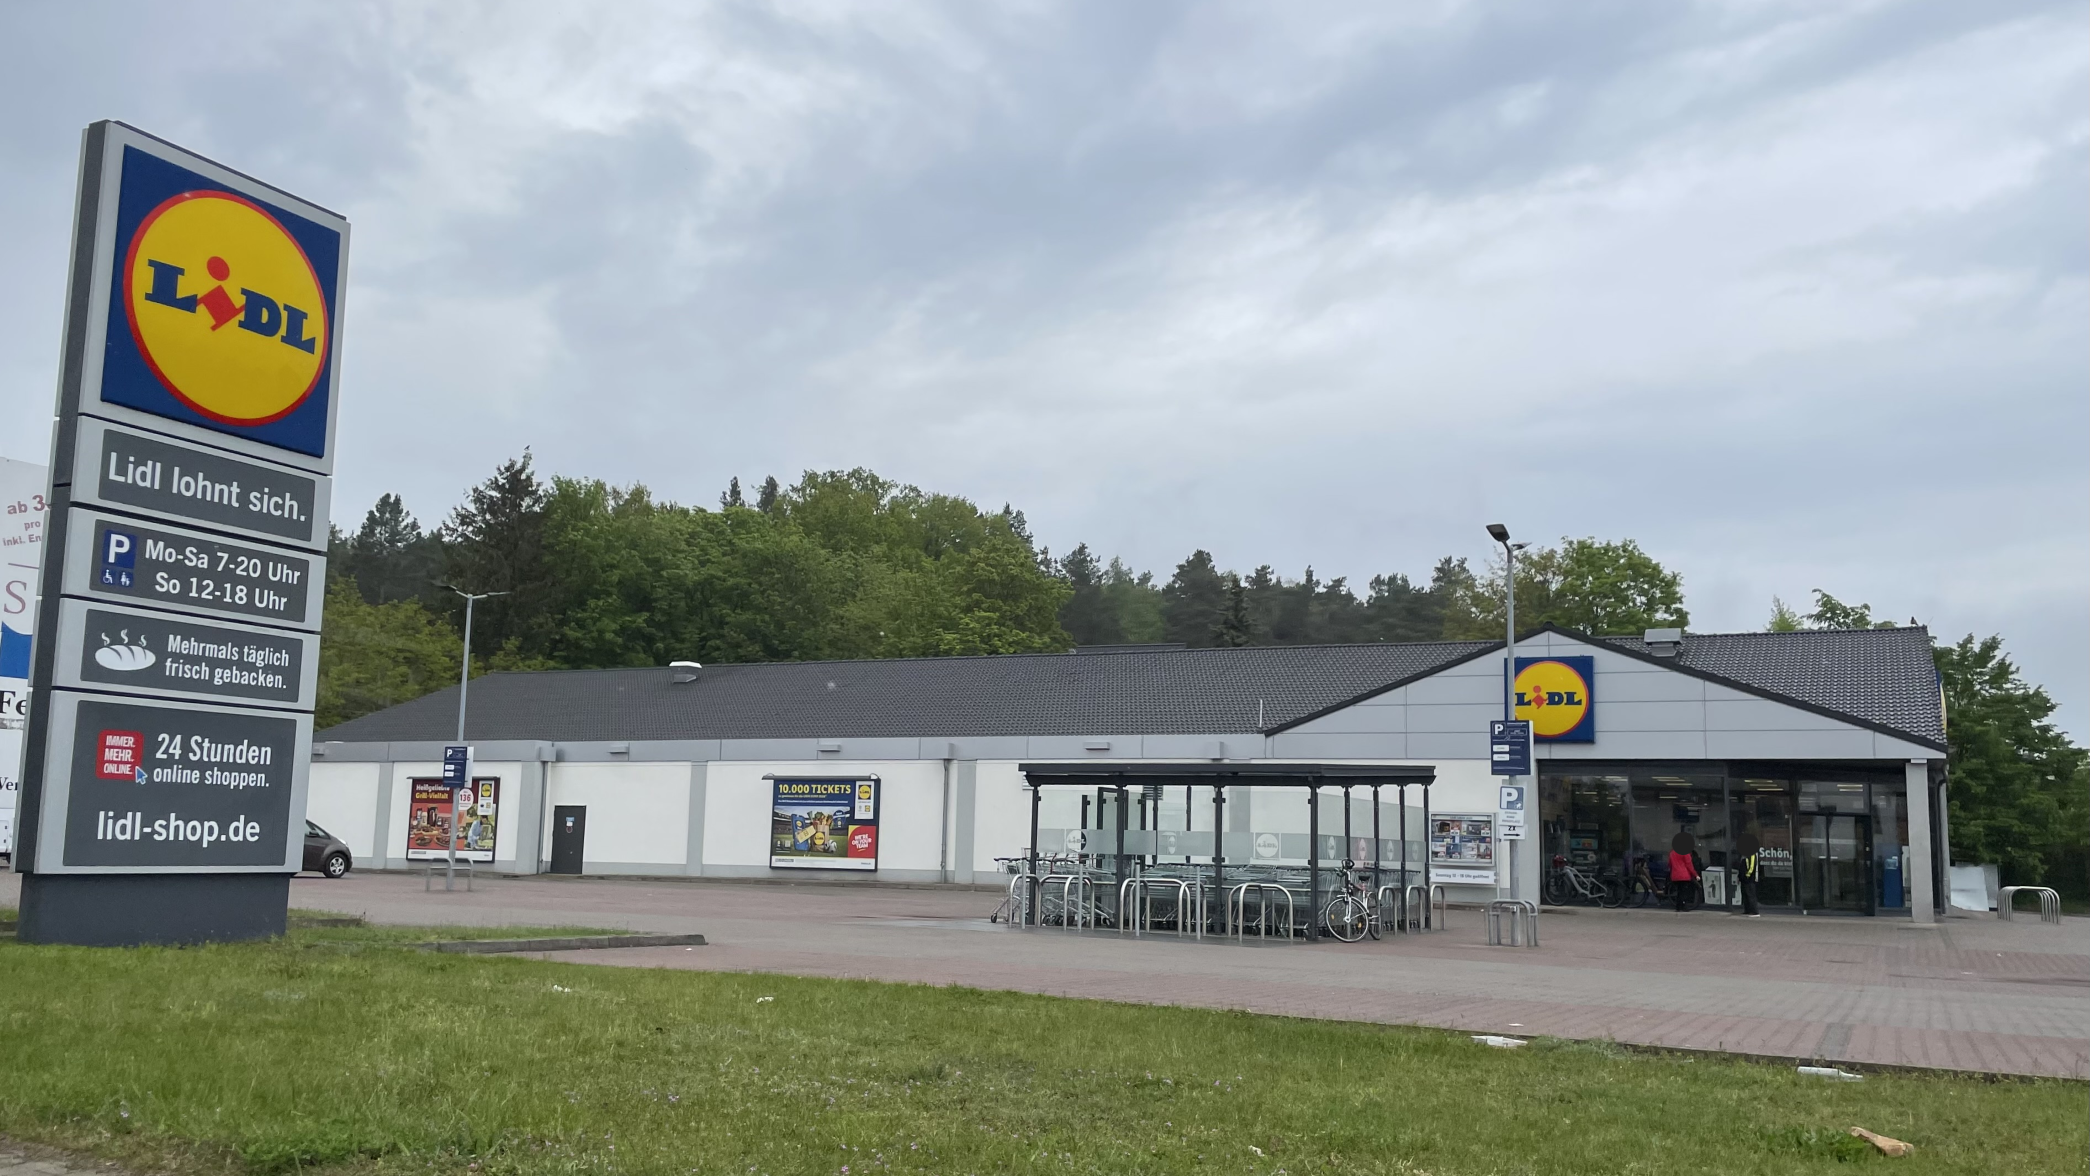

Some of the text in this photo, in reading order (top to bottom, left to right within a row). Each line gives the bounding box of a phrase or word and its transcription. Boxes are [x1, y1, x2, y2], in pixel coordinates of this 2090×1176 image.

[144, 256, 316, 355] LIDL
[108, 452, 306, 522] Lidl lohnt sich.
[7, 501, 28, 514] ab
[24, 521, 41, 532] pro
[2, 536, 26, 546] inkl.
[108, 533, 130, 564] P
[145, 538, 300, 584] Mo-Sa 7-20 Uhr
[154, 572, 288, 611] So 12-18 Uhr
[168, 634, 289, 667] Mehrmals täglich
[165, 658, 287, 689] frisch gebacken.
[1515, 685, 1582, 710] LIDL
[104, 748, 134, 762] MEHR.
[106, 735, 136, 748] IMMER.
[155, 733, 272, 765] 24 Stunden
[103, 763, 133, 775] ONLINE.
[154, 765, 270, 790] online shoppen.
[779, 784, 851, 794] 10.000 TICKETS
[97, 810, 260, 848] lidl-shop.de
